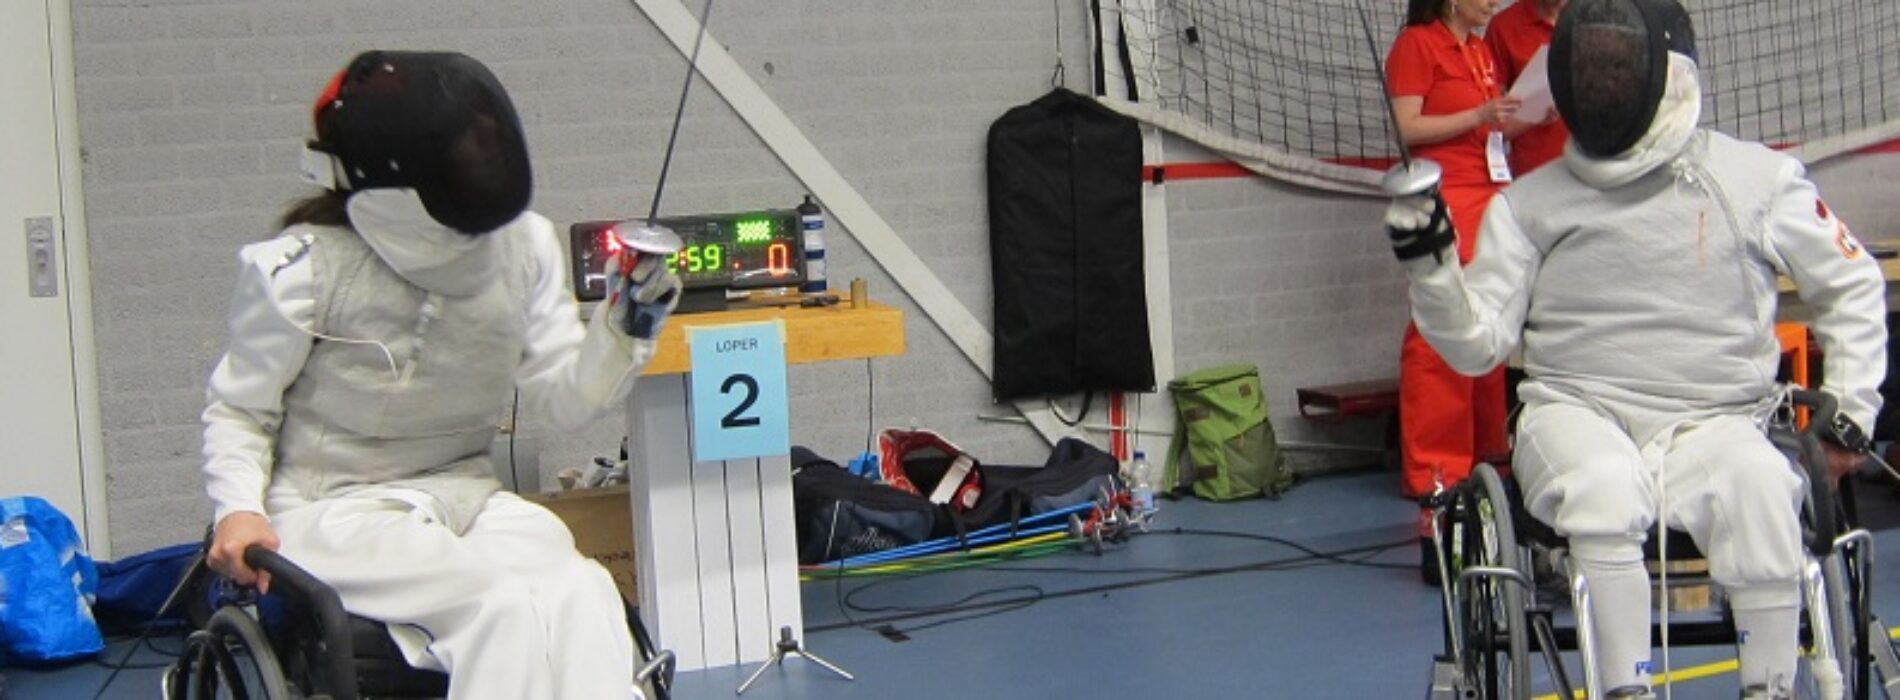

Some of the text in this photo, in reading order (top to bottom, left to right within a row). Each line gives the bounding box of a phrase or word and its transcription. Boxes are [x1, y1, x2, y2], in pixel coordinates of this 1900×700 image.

[768, 243, 788, 275] 0
[716, 338, 758, 353] LOPER
[720, 373, 761, 428] 2
